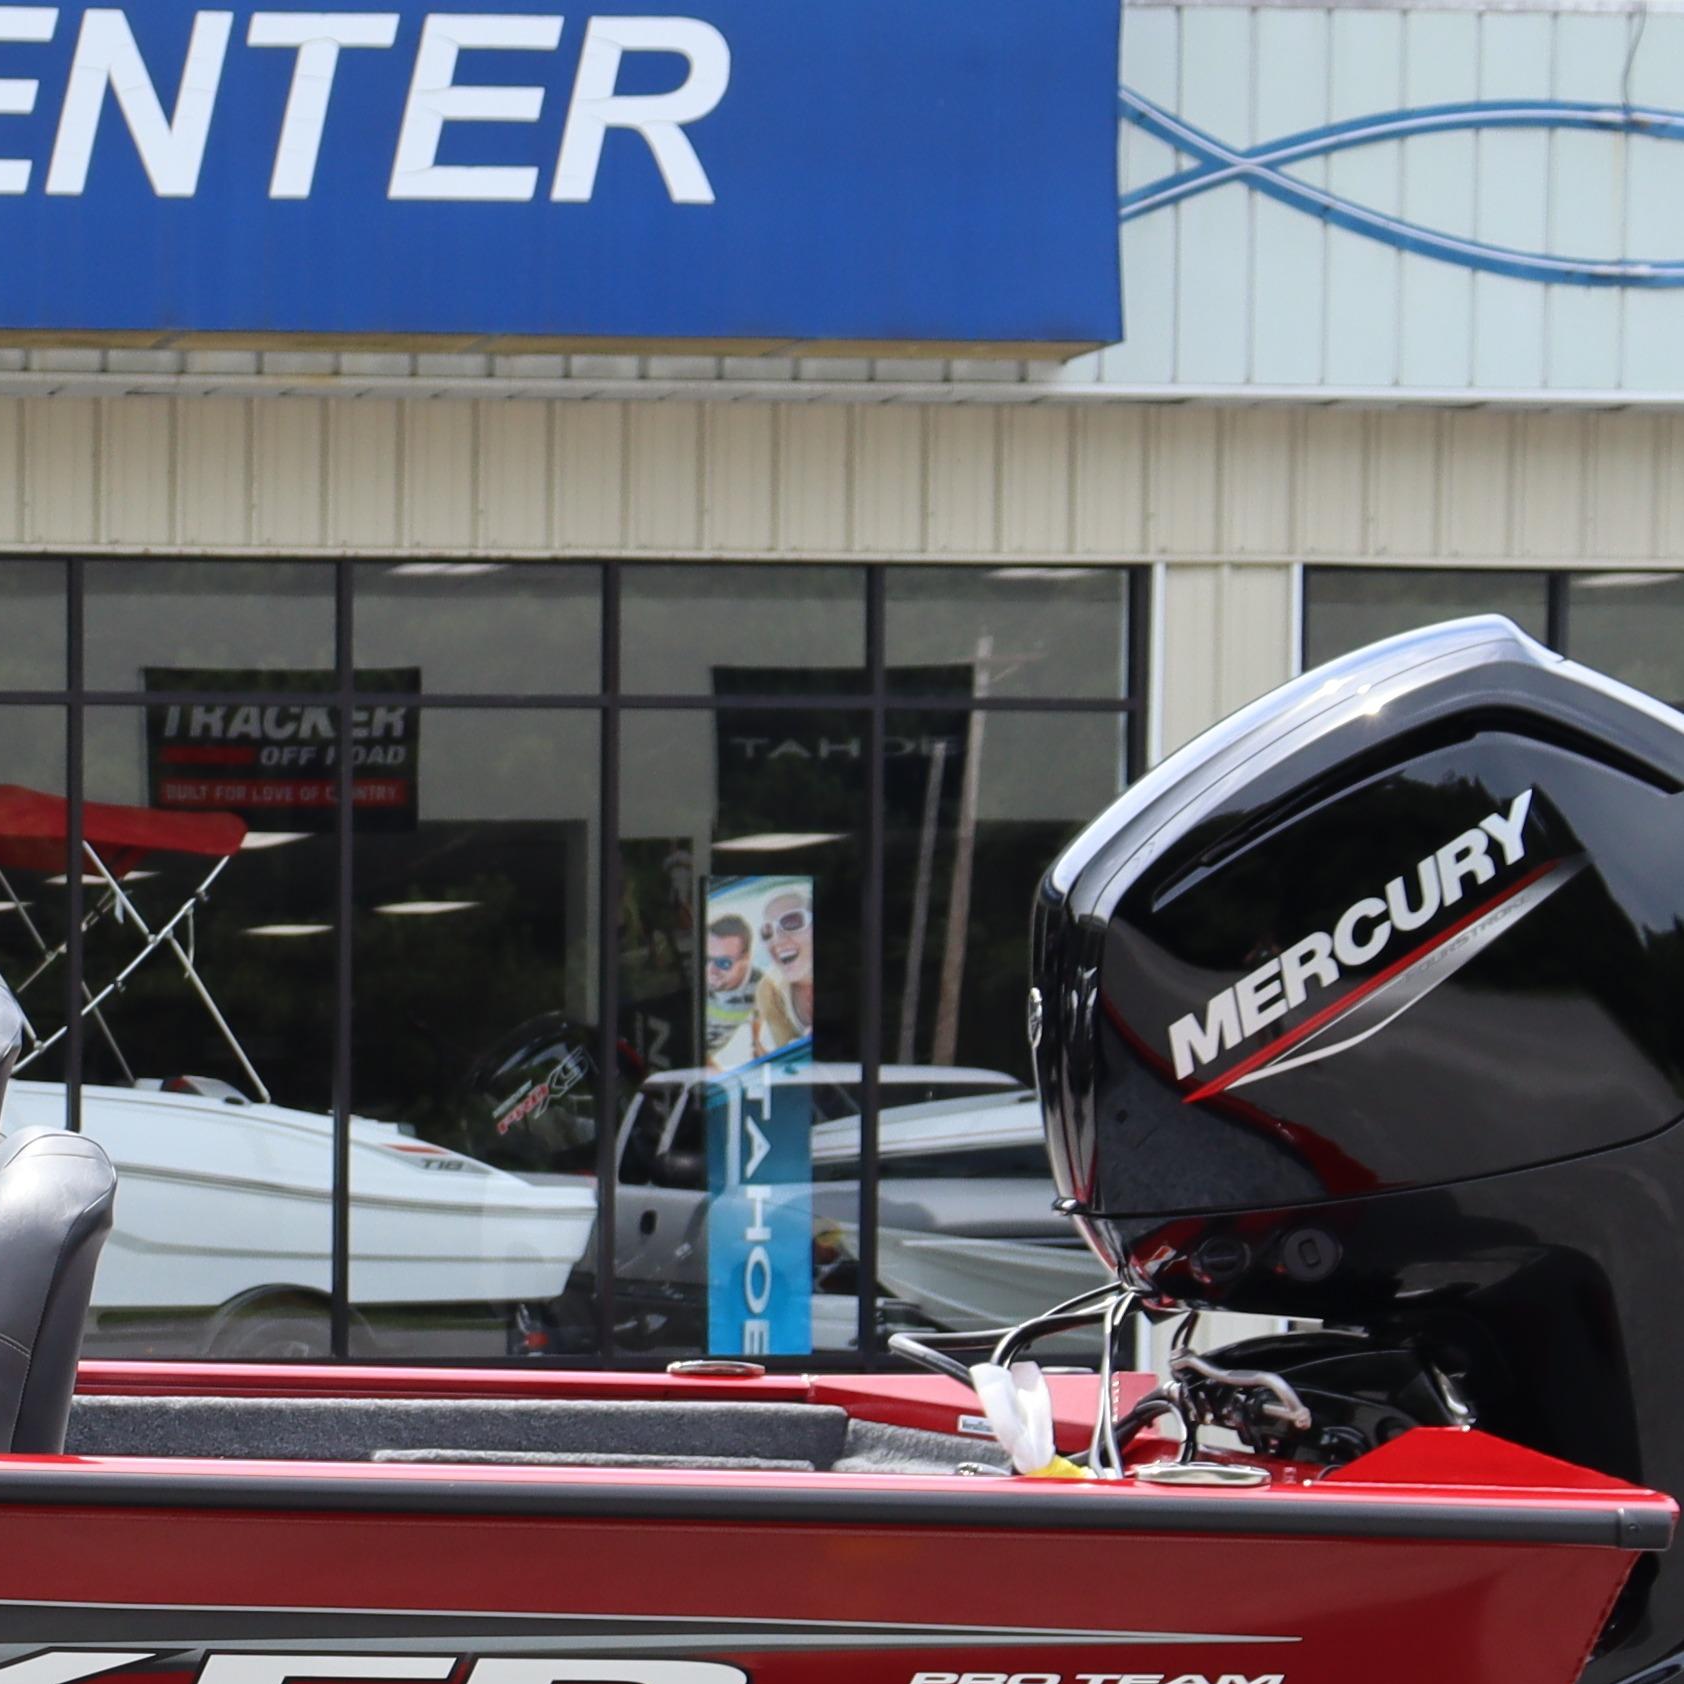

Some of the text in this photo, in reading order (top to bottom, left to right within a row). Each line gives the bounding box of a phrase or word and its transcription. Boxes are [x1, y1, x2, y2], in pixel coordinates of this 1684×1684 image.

[260, 746, 316, 766] OFF
[1167, 788, 1533, 1081] MERCURY
[743, 1062, 773, 1356] TAHOE
